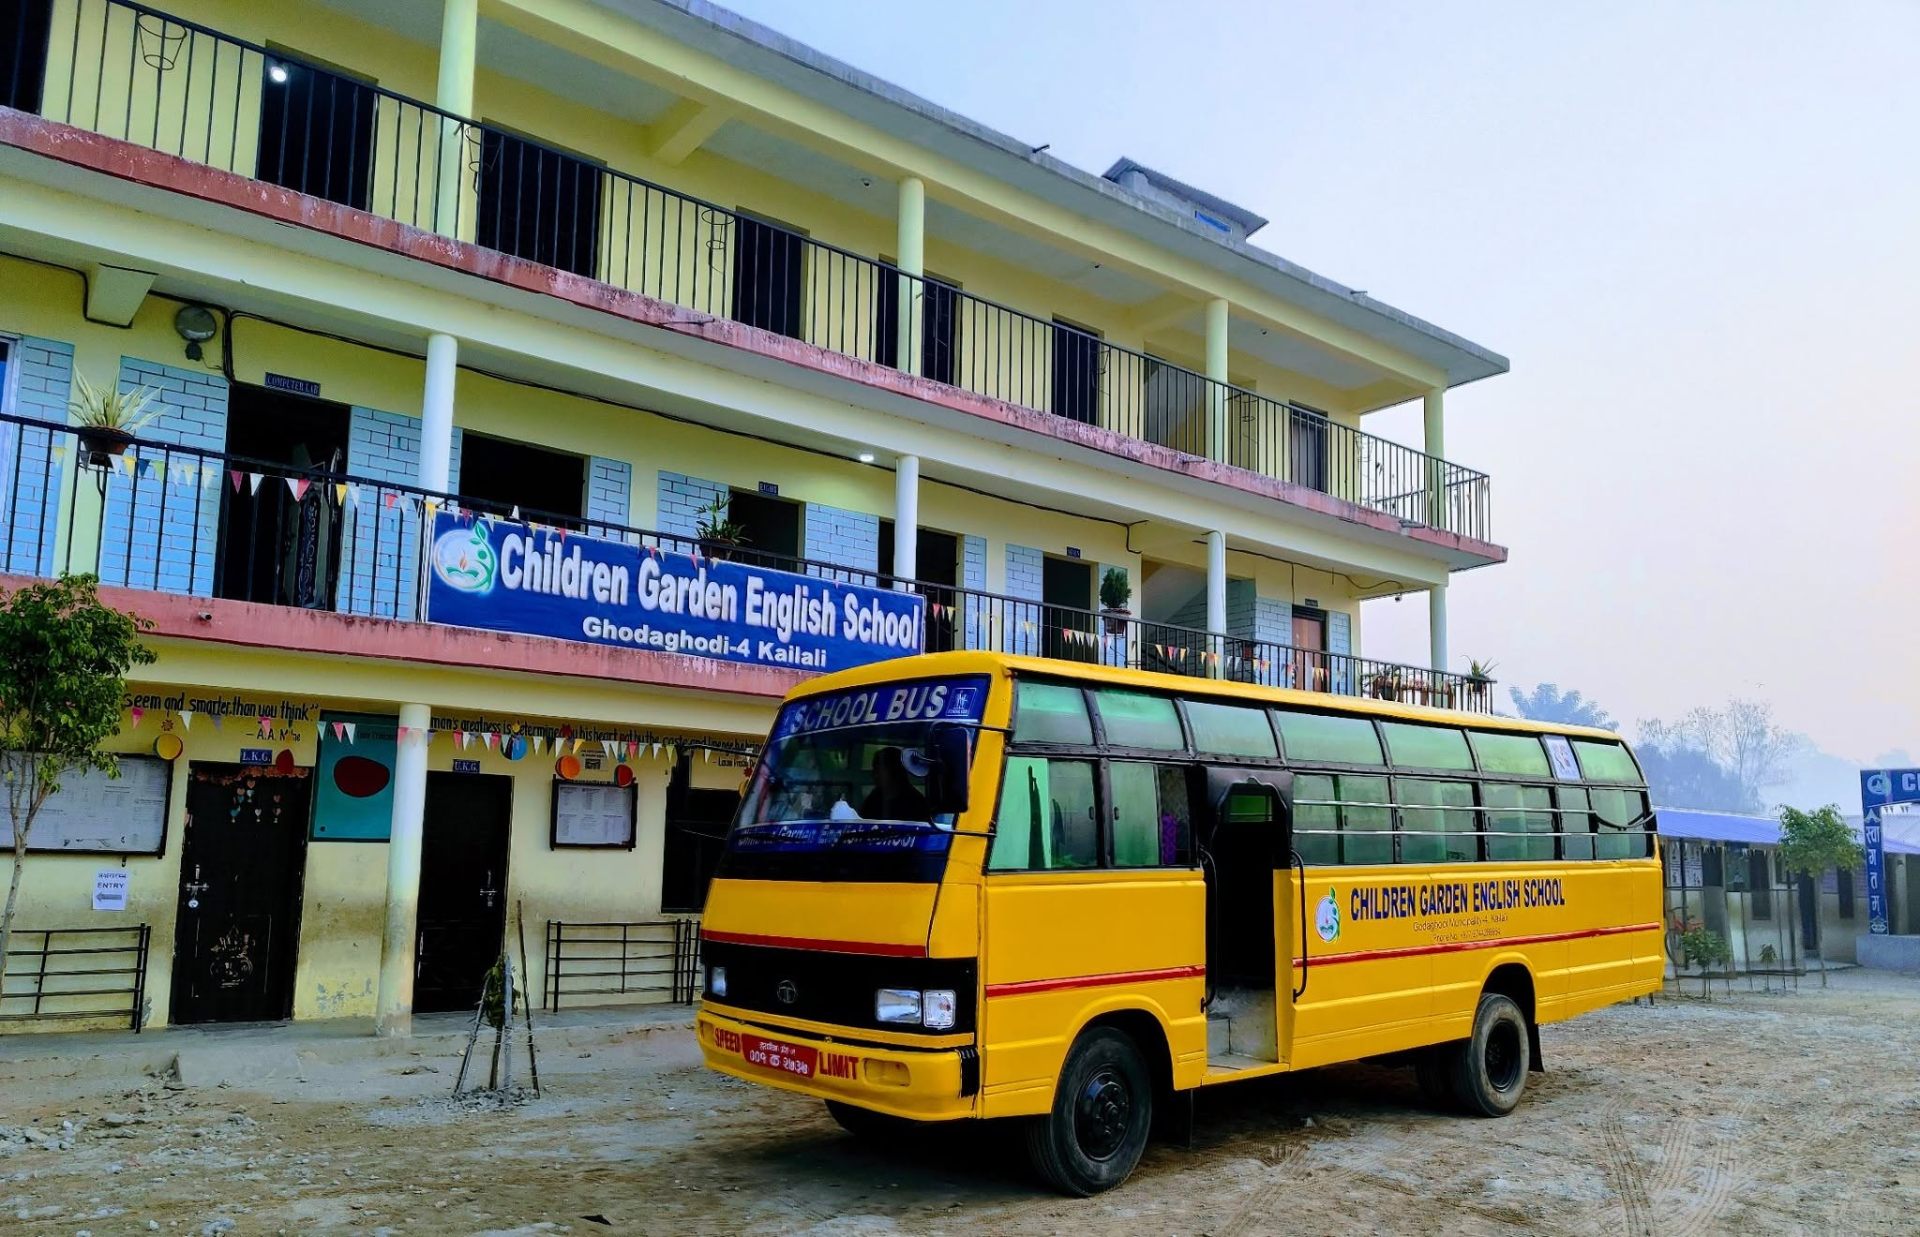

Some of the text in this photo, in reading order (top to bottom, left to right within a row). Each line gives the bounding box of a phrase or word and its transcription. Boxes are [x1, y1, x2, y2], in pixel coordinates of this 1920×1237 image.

[500, 533, 920, 650] Children Garden English School
[581, 615, 828, 668] Ghodaghodi-4 Kailali
[164, 692, 184, 712] and
[789, 685, 948, 734] SCHOOL BUS
[1350, 878, 1565, 921] CHILDREN GARDEN ENGLISH SCHOOL
[714, 1027, 741, 1053] SPEED
[819, 1051, 859, 1080] LIMIT
